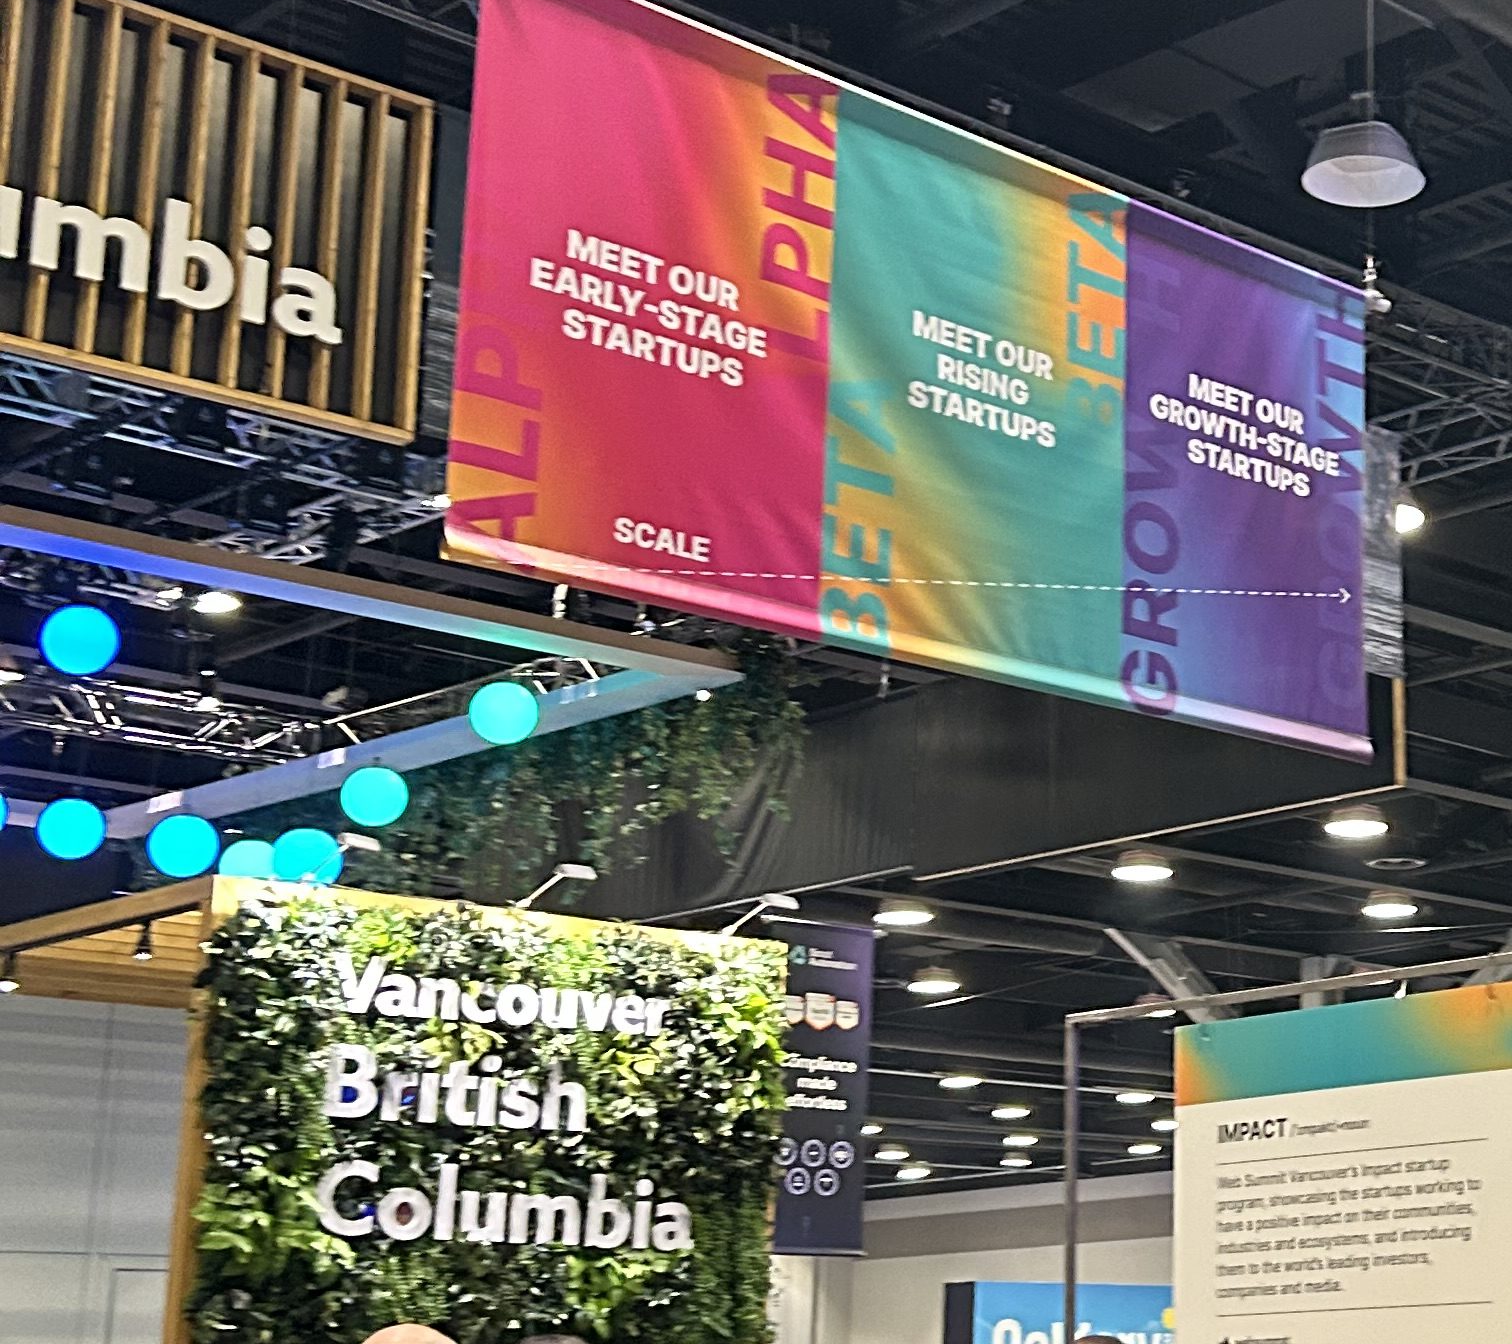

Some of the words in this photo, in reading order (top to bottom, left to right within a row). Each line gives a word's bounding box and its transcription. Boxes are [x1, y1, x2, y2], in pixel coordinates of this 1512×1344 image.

[0, 183, 342, 346] mbia
[567, 228, 665, 284] MEET
[668, 264, 739, 311] OUR
[530, 257, 767, 358] EARLY-STAGE
[912, 309, 992, 358] MEET
[995, 340, 1053, 380] OUR
[562, 308, 744, 387] STARTUPS
[937, 353, 1030, 405] RISING
[907, 380, 1057, 447] STARTUPS
[1149, 393, 1340, 477] GROWTH-STAGE
[1188, 373, 1254, 416] MEET
[1255, 398, 1304, 435] OUR
[1187, 438, 1311, 497] STARTUPS
[612, 516, 712, 563] SCALE
[334, 955, 673, 1037] Vancouver
[322, 1042, 591, 1133] British
[1217, 1117, 1288, 1144] IMPACT
[314, 1159, 695, 1252] Columbia
